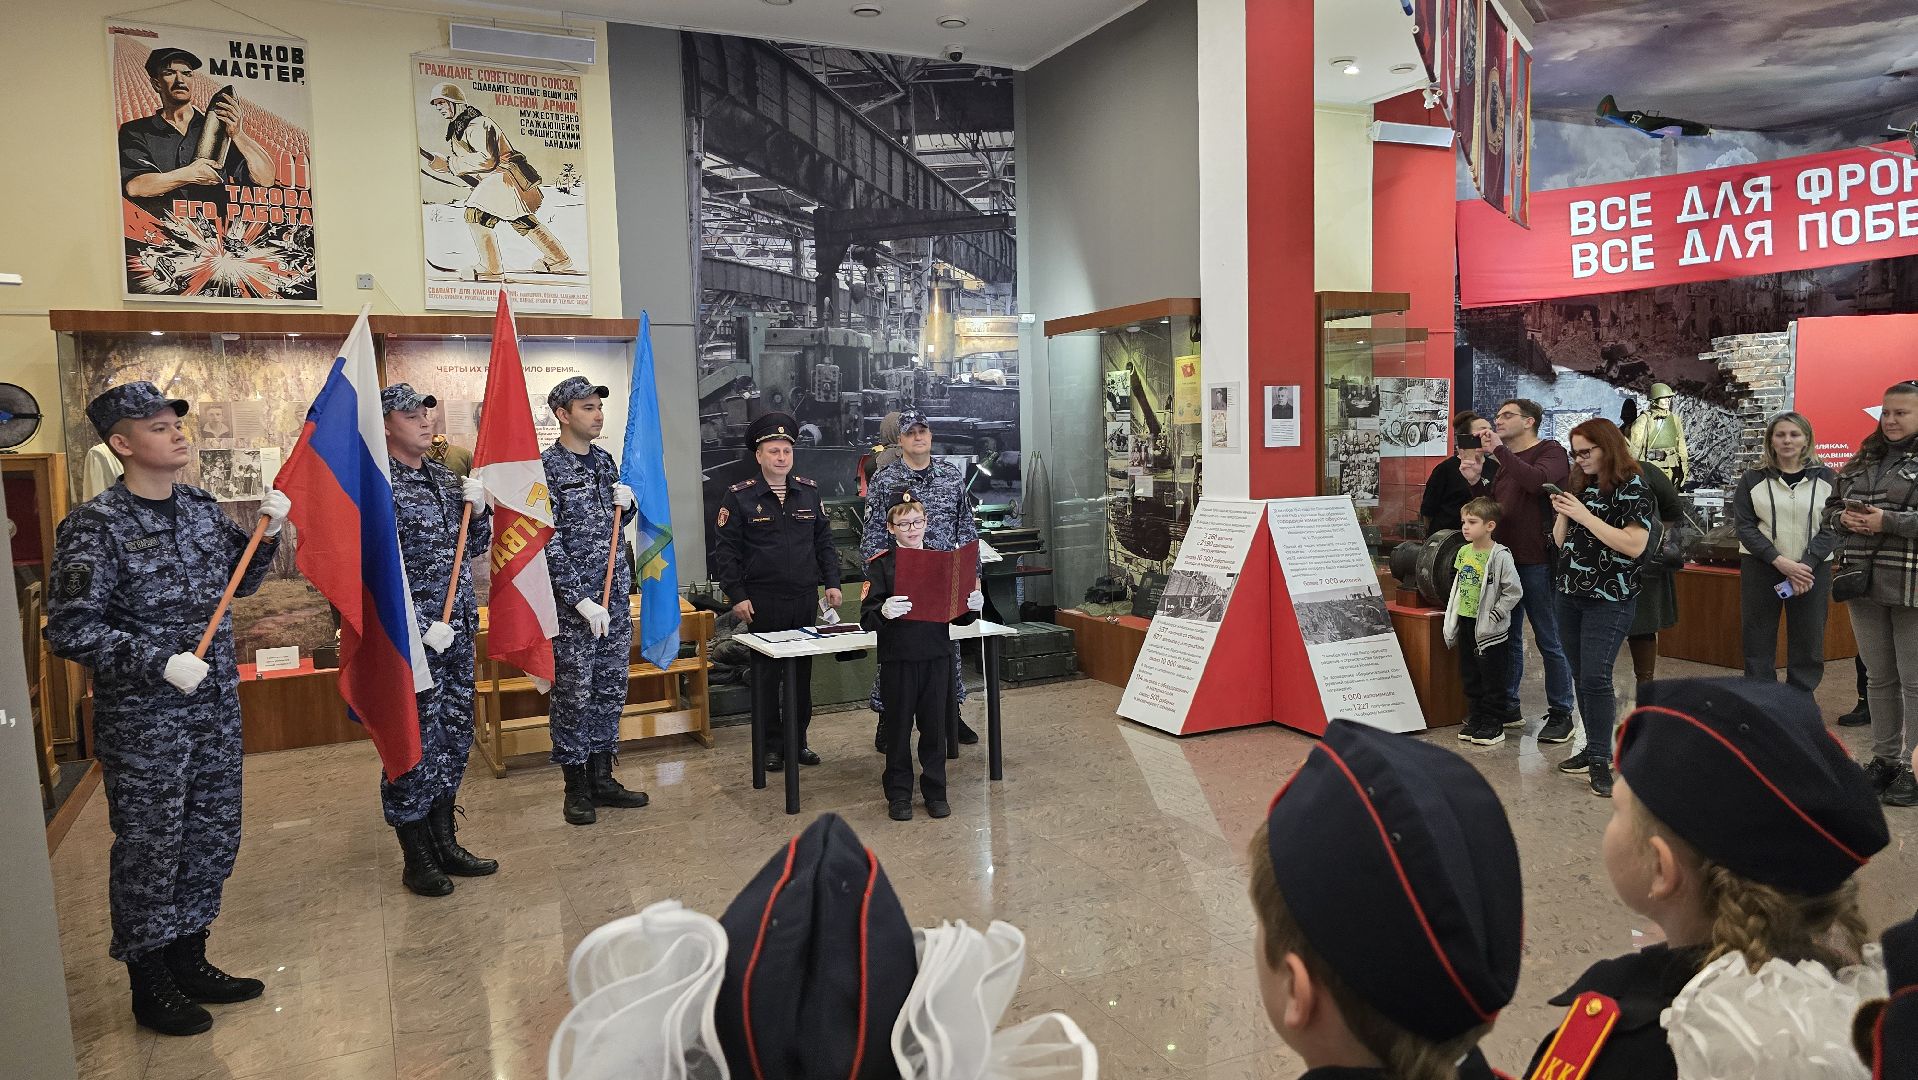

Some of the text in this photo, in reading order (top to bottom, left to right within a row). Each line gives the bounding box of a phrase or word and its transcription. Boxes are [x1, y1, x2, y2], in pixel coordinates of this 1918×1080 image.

[229, 40, 304, 64] КАКОВ
[210, 58, 304, 86] МАСТЕР,
[418, 62, 578, 92] ГРАЖДАНЕ СОВЕТСКОГО СОЮЗА,
[472, 82, 578, 101] СДАВАЙТЕ ТЕПЛЫЕ ВЕЩИ ДЛЯ
[495, 93, 578, 115] КРАСНОЙ АРМИИ,
[520, 110, 579, 122] МУЖЕСТВЕННО
[520, 119, 580, 131] СРАЖАЮЩЕЙСЯ
[1630, 114, 1642, 123] 57
[528, 129, 580, 140] ФАШИСТСКИМИ
[544, 140, 581, 149] БАНДАМИ!
[225, 184, 312, 208] ТАКОВА
[1570, 191, 1653, 236] ВСЕ
[1676, 175, 1772, 224] ДЛЯ
[173, 200, 313, 226] ЕГО РАБОТА
[1571, 199, 1918, 279] ВСЕ ДЛЯ ПОБЕ
